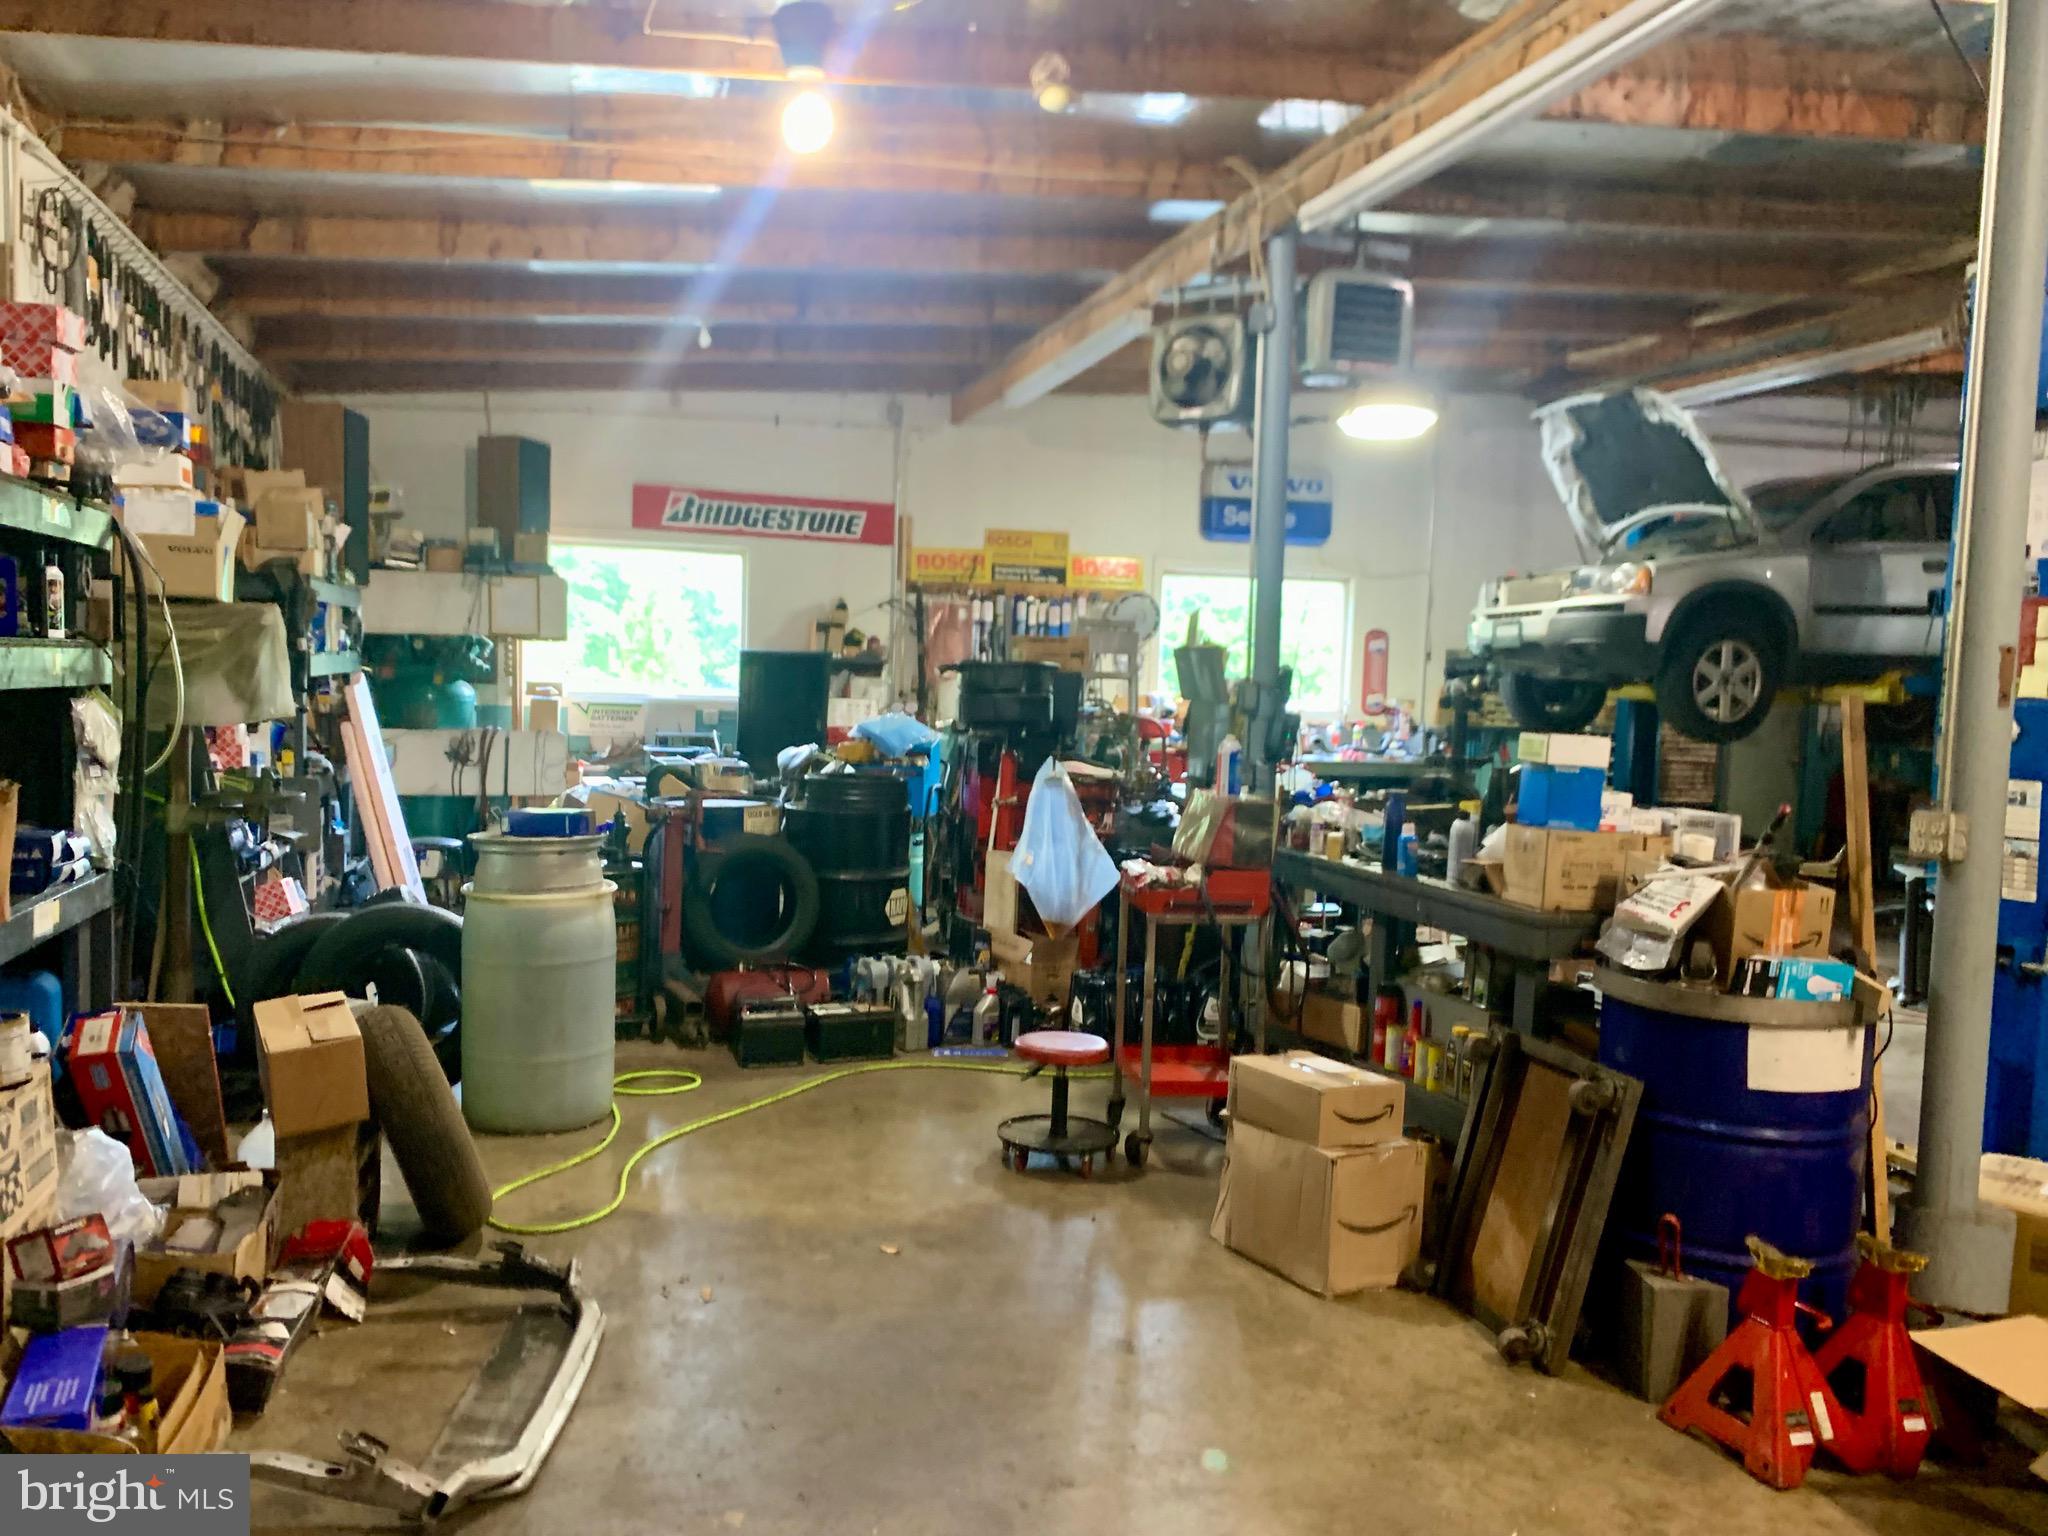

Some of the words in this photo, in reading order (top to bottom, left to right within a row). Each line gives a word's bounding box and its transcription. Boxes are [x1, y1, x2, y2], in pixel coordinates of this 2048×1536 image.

[1226, 474, 1325, 494] VVO
[666, 495, 862, 536] BRIDGESTONE
[917, 553, 986, 571] BOSCH
